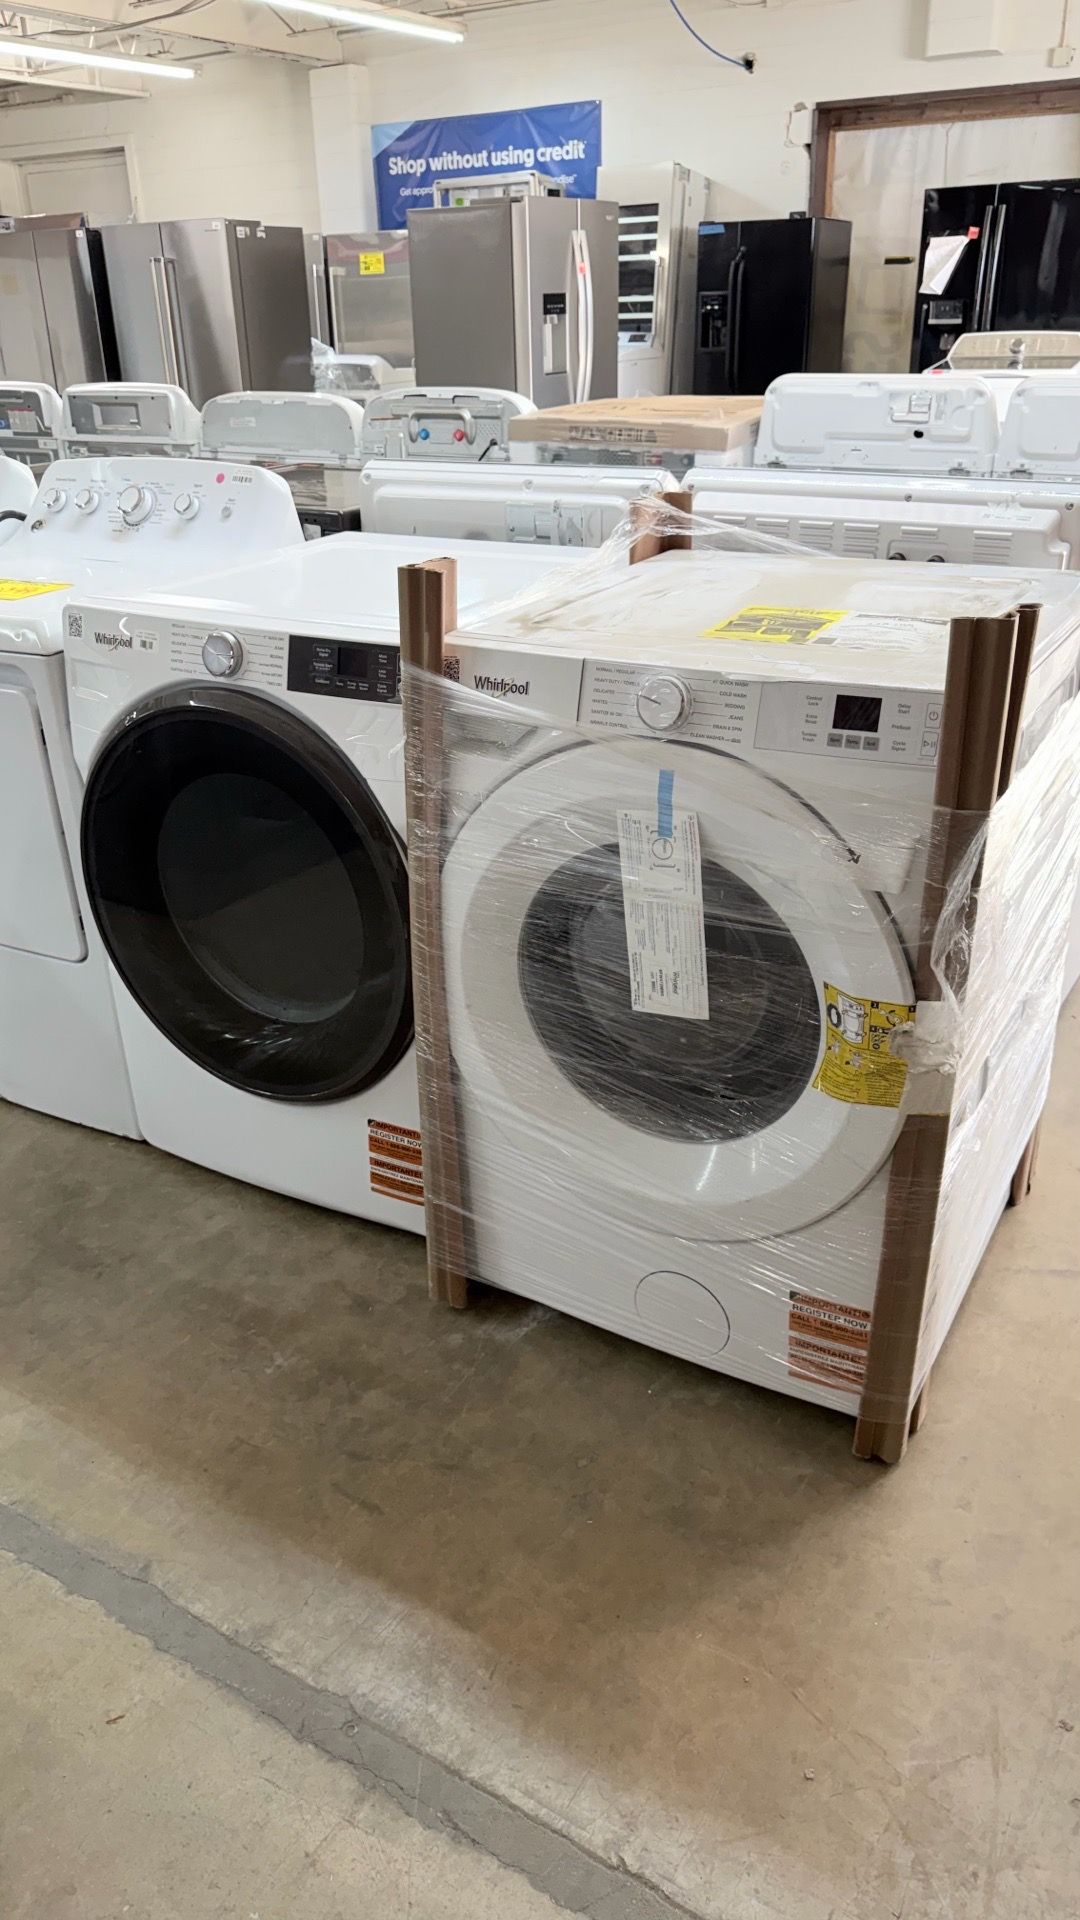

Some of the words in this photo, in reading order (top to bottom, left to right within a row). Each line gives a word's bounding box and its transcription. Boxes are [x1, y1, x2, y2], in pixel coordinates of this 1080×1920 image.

[389, 157, 427, 176] Shop
[428, 149, 489, 171] without
[491, 146, 534, 167] using
[400, 187, 411, 196] Get
[94, 632, 133, 652] Whirlpool
[474, 675, 530, 696] Whirlpool
[370, 1129, 405, 1143] REGISTER
[791, 1313, 811, 1323] CALL
[792, 1303, 841, 1323] REGISTER
[844, 1318, 868, 1329] NOW
